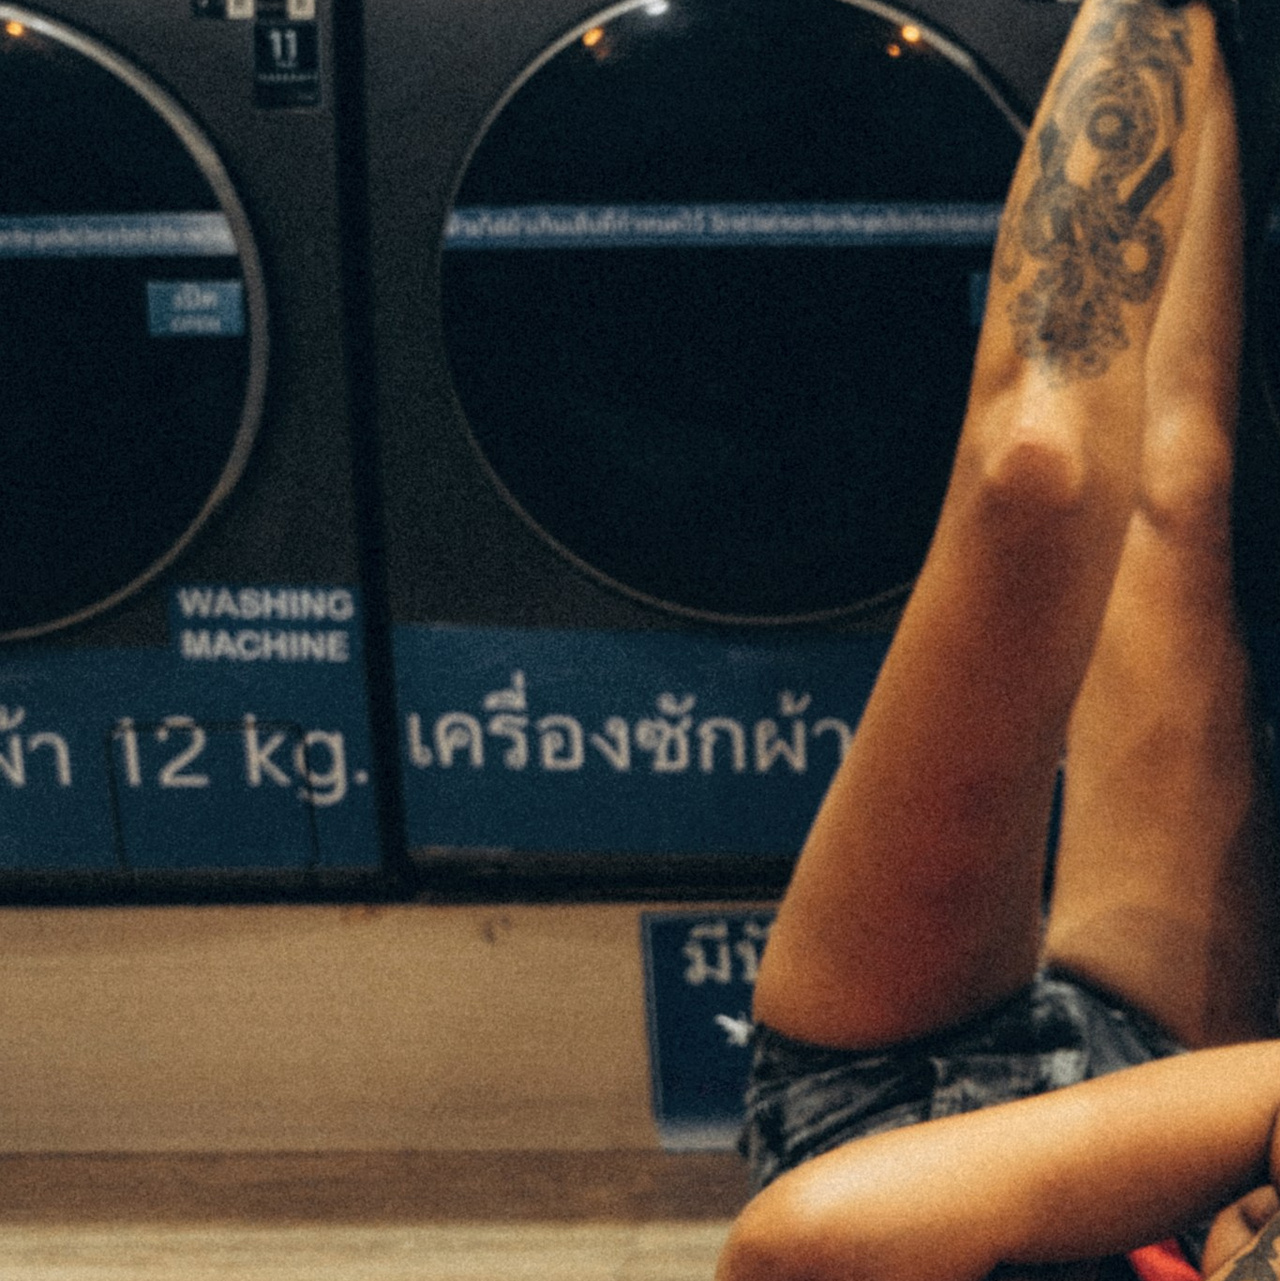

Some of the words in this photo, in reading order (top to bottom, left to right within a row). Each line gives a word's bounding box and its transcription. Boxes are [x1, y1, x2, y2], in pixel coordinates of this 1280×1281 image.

[177, 587, 355, 621] WASHING
[180, 629, 350, 663] MACHINE
[114, 715, 210, 788] 12
[243, 712, 370, 807] kg.
